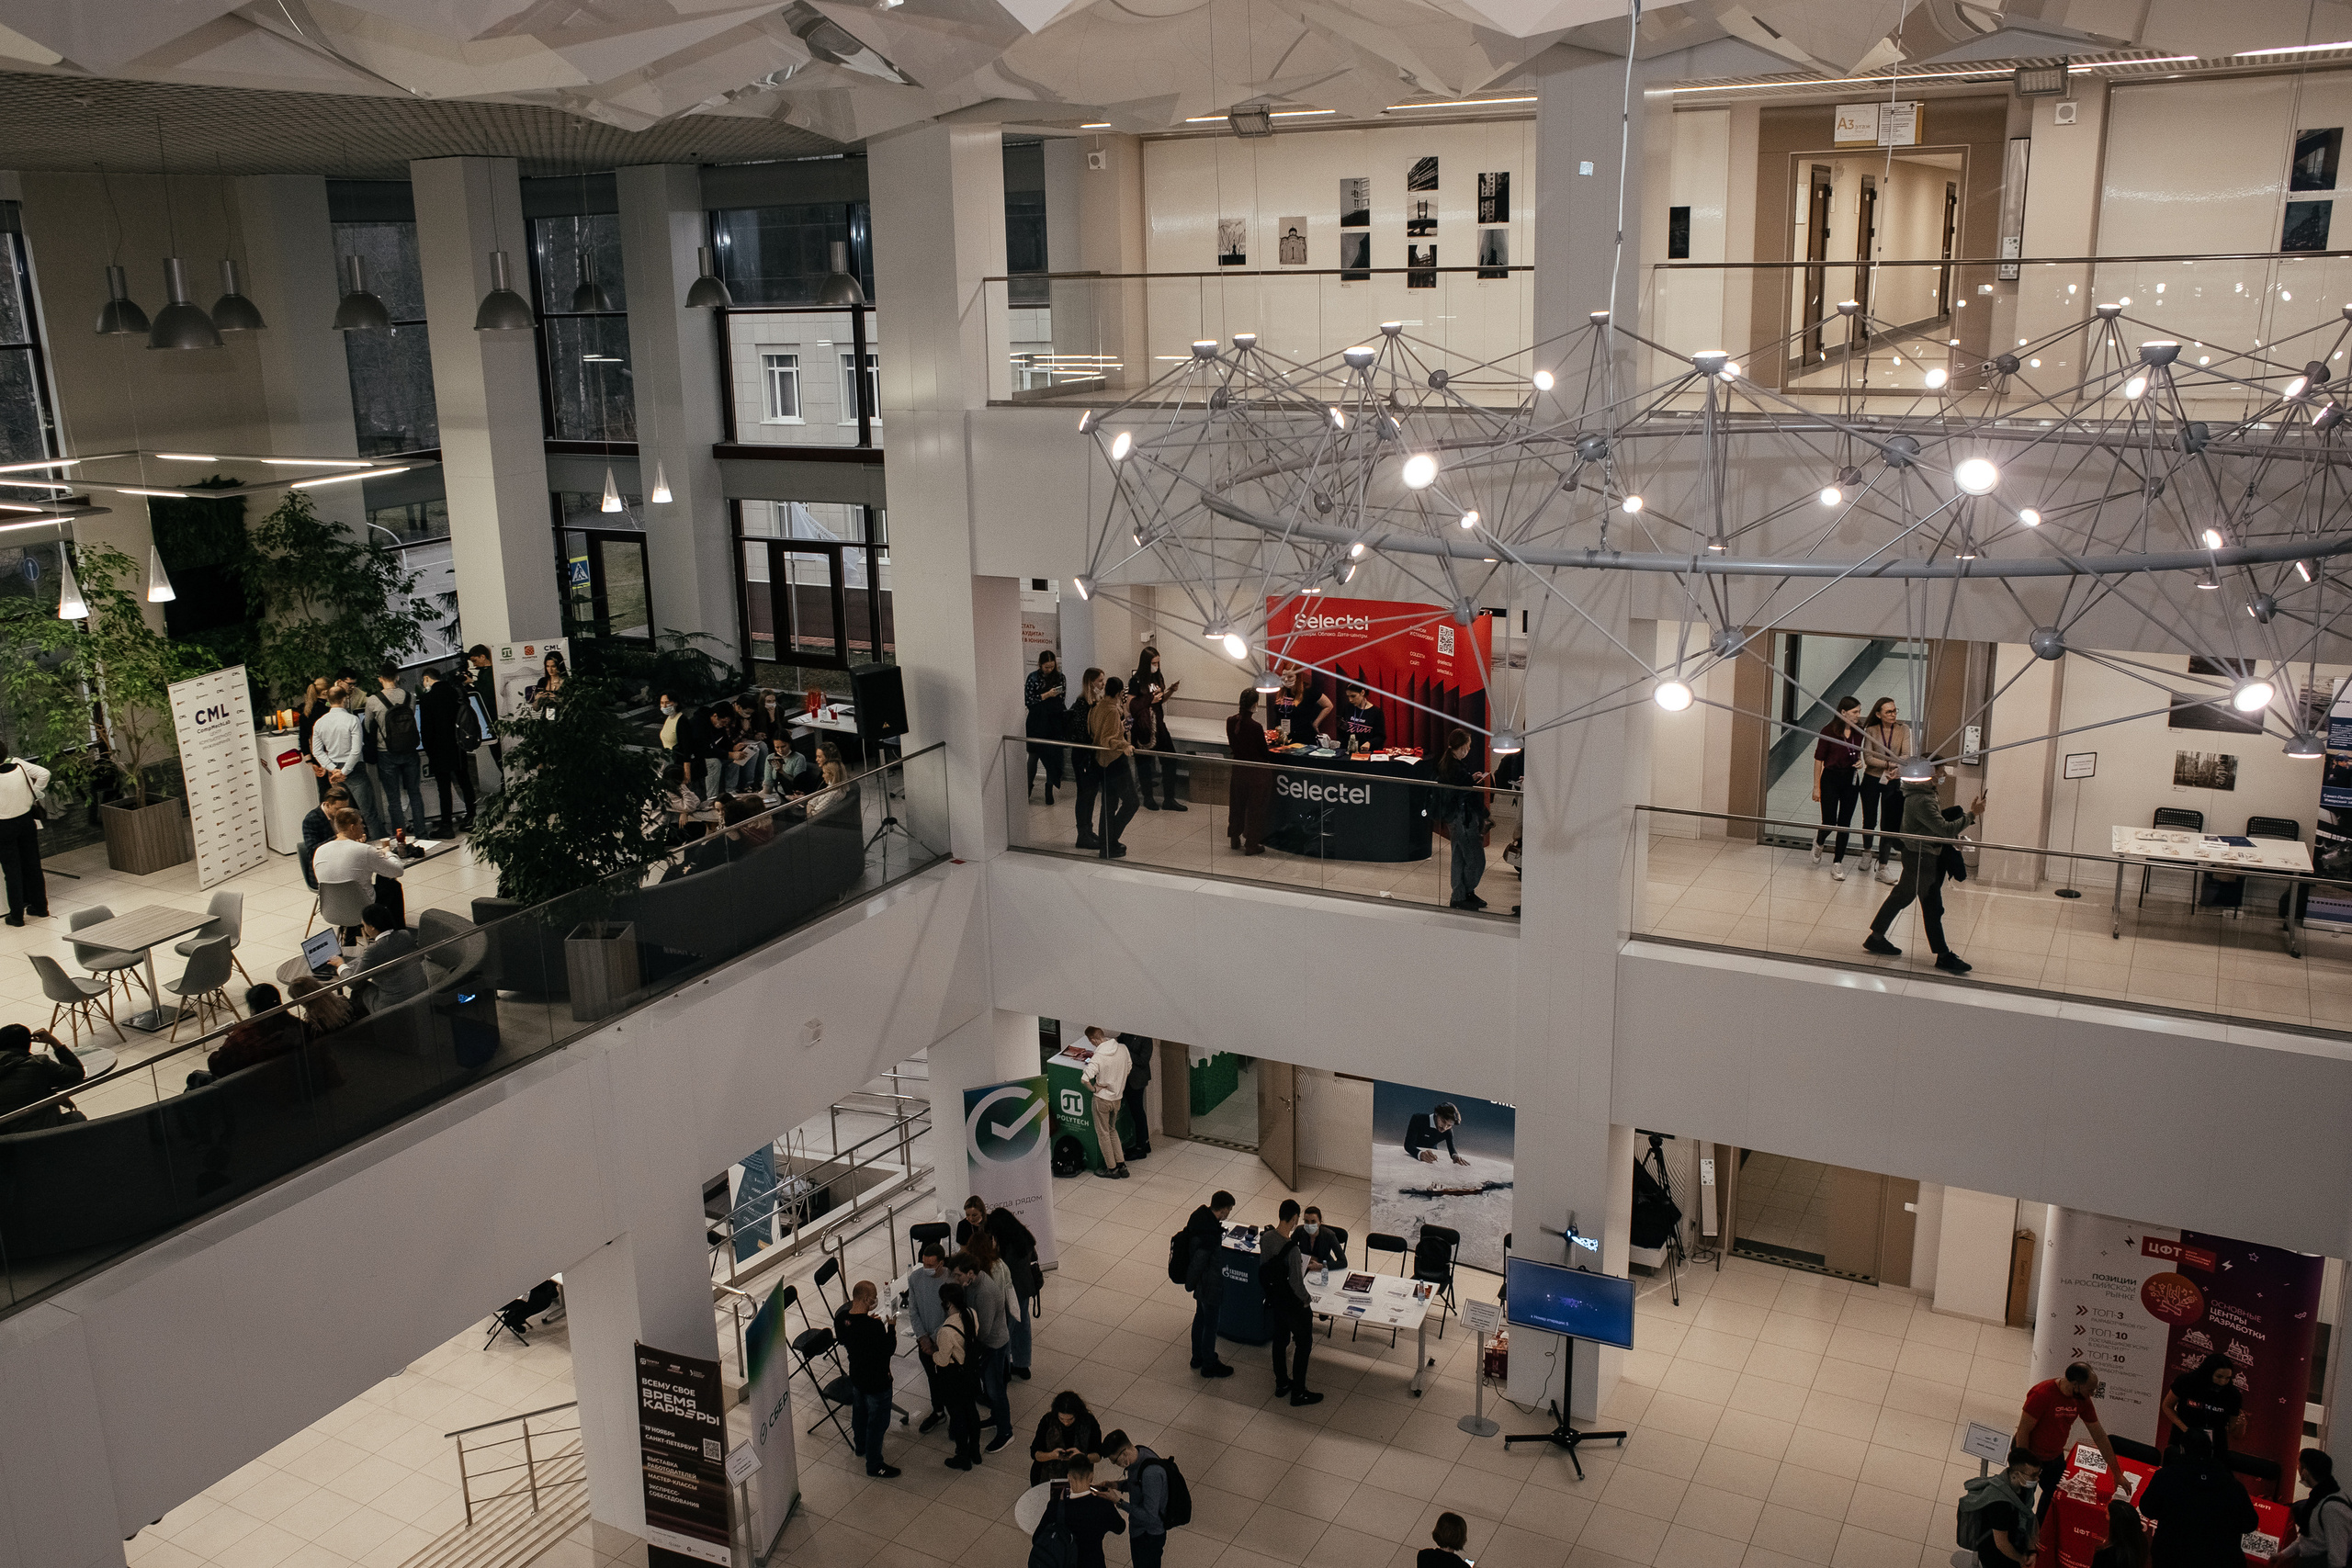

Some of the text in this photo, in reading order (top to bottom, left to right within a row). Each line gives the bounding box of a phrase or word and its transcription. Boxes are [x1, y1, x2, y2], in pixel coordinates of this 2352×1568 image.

[1295, 614, 1369, 630] Selectel
[195, 704, 230, 726] CML
[1277, 774, 1370, 804] Selectel
[1057, 1114, 1090, 1126] POLYTECH
[1015, 1195, 1042, 1206] рядом
[2149, 1242, 2182, 1257] ЦФТ
[2075, 1280, 2136, 1292] РОССИЙСКОМ
[2092, 1273, 2137, 1285] ПОЗИЦИИ
[2106, 1291, 2135, 1301] РЫНКЕ
[2093, 1308, 2124, 1319] ТОП-3
[2211, 1300, 2262, 1323] ОСНОВНЫЕ
[2211, 1307, 2246, 1325] ЦЕНТРЫ
[2090, 1327, 2128, 1340] ТОП-10
[2210, 1314, 2266, 1341] РАЗРАБОТКИ
[2087, 1350, 2125, 1363] ТОП-10
[642, 1378, 695, 1396] ВСЕМУ СВОЕ
[643, 1388, 695, 1409] ВРЕМЯ
[643, 1398, 719, 1426] КАРЬЕРЫ
[770, 1391, 788, 1427] СБЕР
[651, 1427, 675, 1438] НОЯБРЯ
[645, 1434, 698, 1451] САНКТ-ПЕТЕРБУРГ
[647, 1456, 678, 1468] ВЫСТАВКА
[647, 1462, 697, 1480] РАБОТОДАТЕЛЕЙ
[648, 1473, 697, 1490] МАСТЕР-КЛАССЫ
[649, 1483, 680, 1495] ЭКСПРЕСС-
[649, 1491, 699, 1508] СОБЕСЕДОВАНИЯ
[2074, 1527, 2090, 1536] ЦФТ
